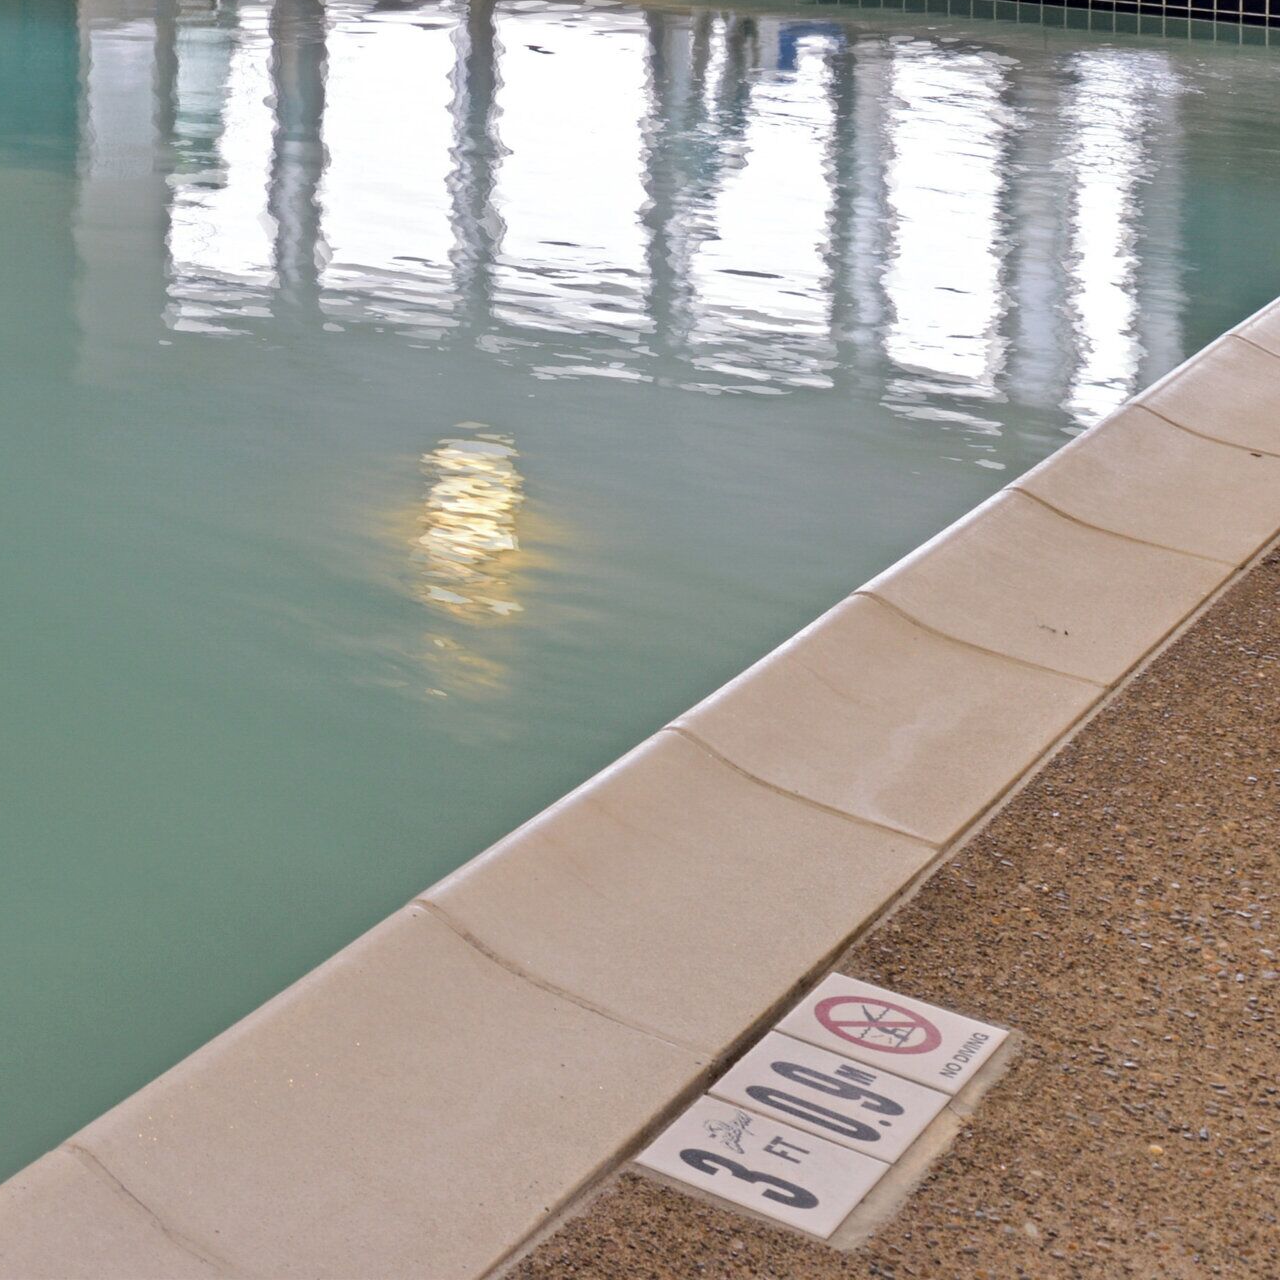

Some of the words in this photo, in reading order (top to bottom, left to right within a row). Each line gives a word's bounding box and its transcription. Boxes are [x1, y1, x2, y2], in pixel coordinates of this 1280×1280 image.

[939, 1062, 962, 1078] NO
[951, 1032, 990, 1064] DIVING
[678, 1147, 820, 1210] 3
[762, 1135, 811, 1165] FT
